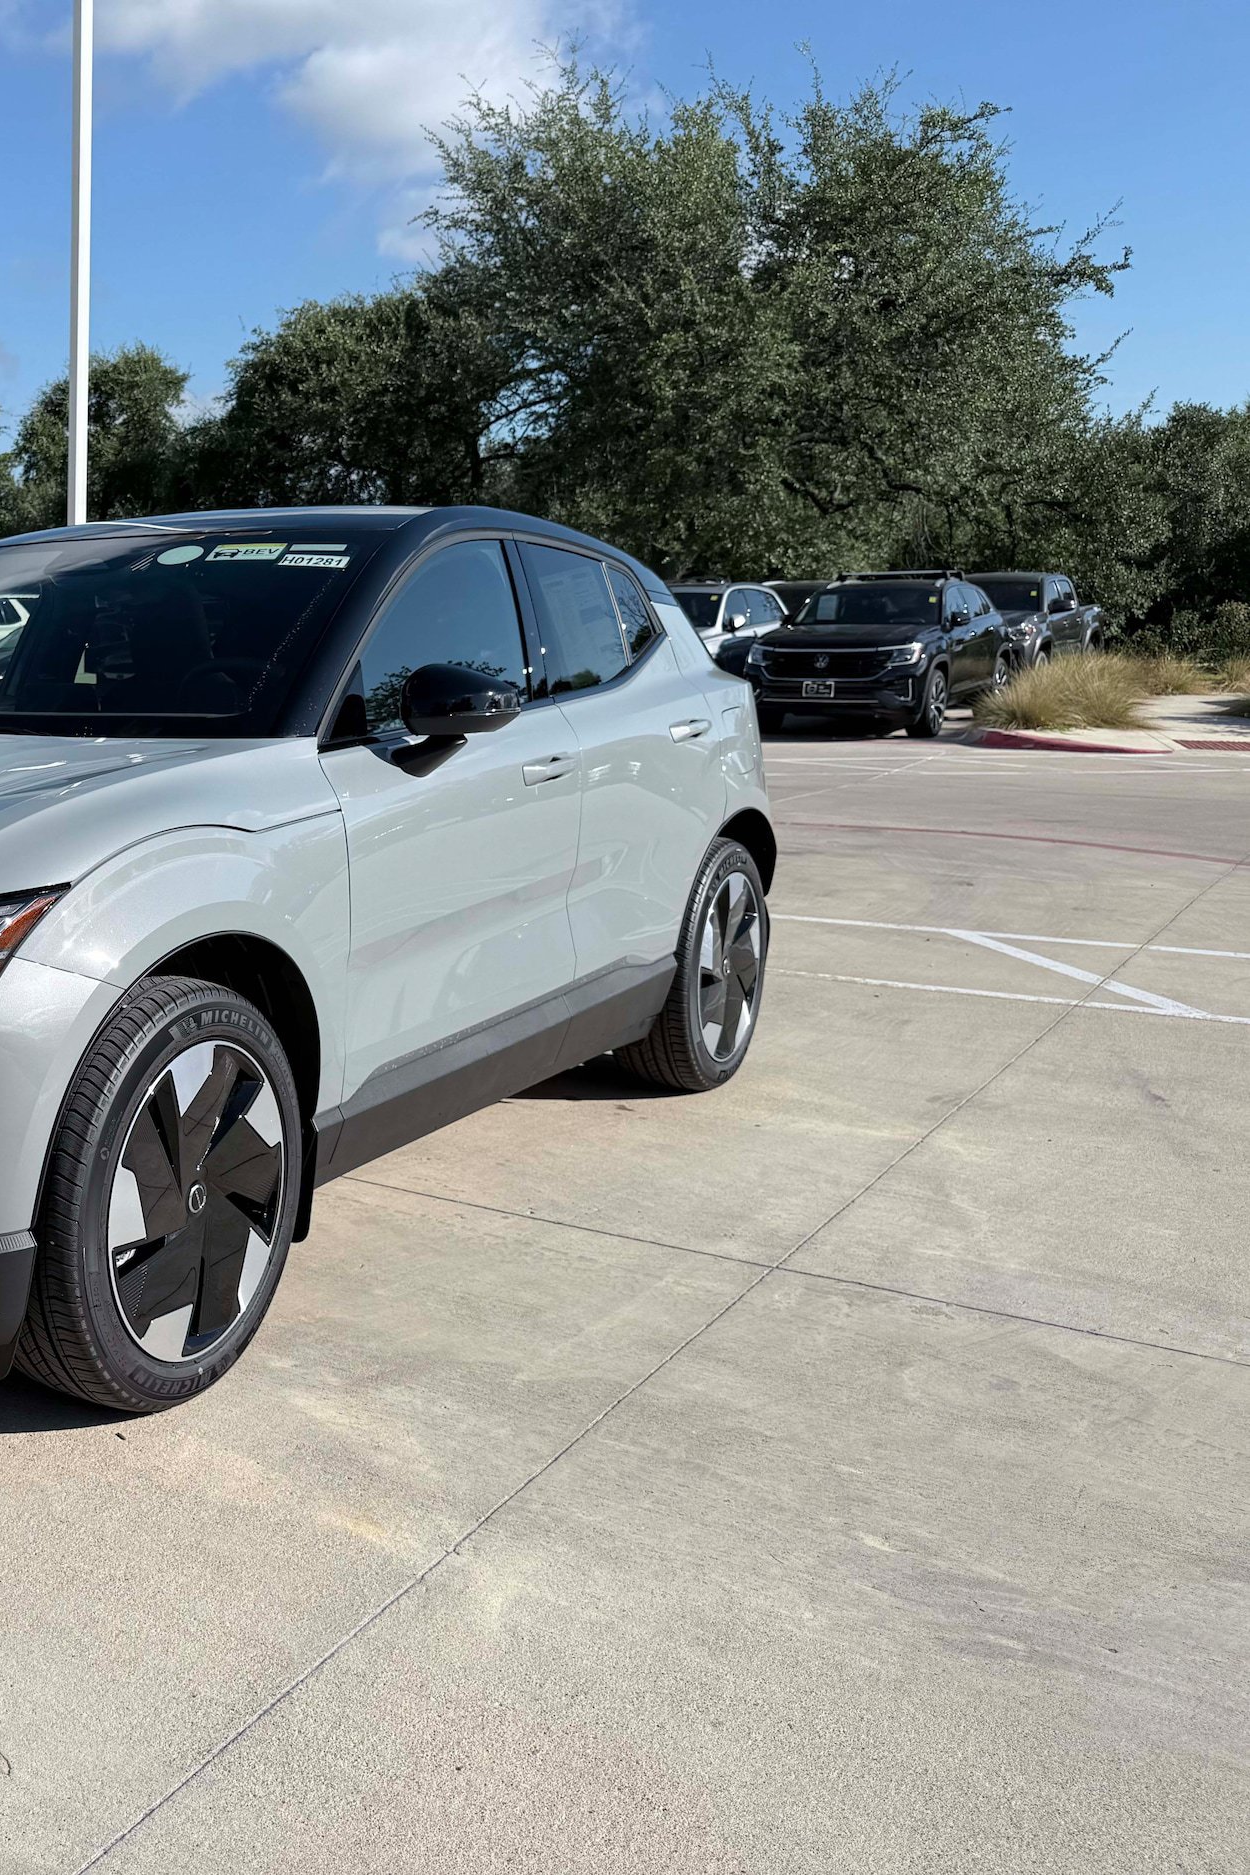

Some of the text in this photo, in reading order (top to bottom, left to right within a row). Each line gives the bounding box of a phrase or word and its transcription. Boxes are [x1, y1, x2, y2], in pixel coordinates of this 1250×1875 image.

[281, 556, 343, 566] H01281
[200, 1009, 270, 1046] MICHELIN
[132, 1369, 213, 1394] MICHELIN
